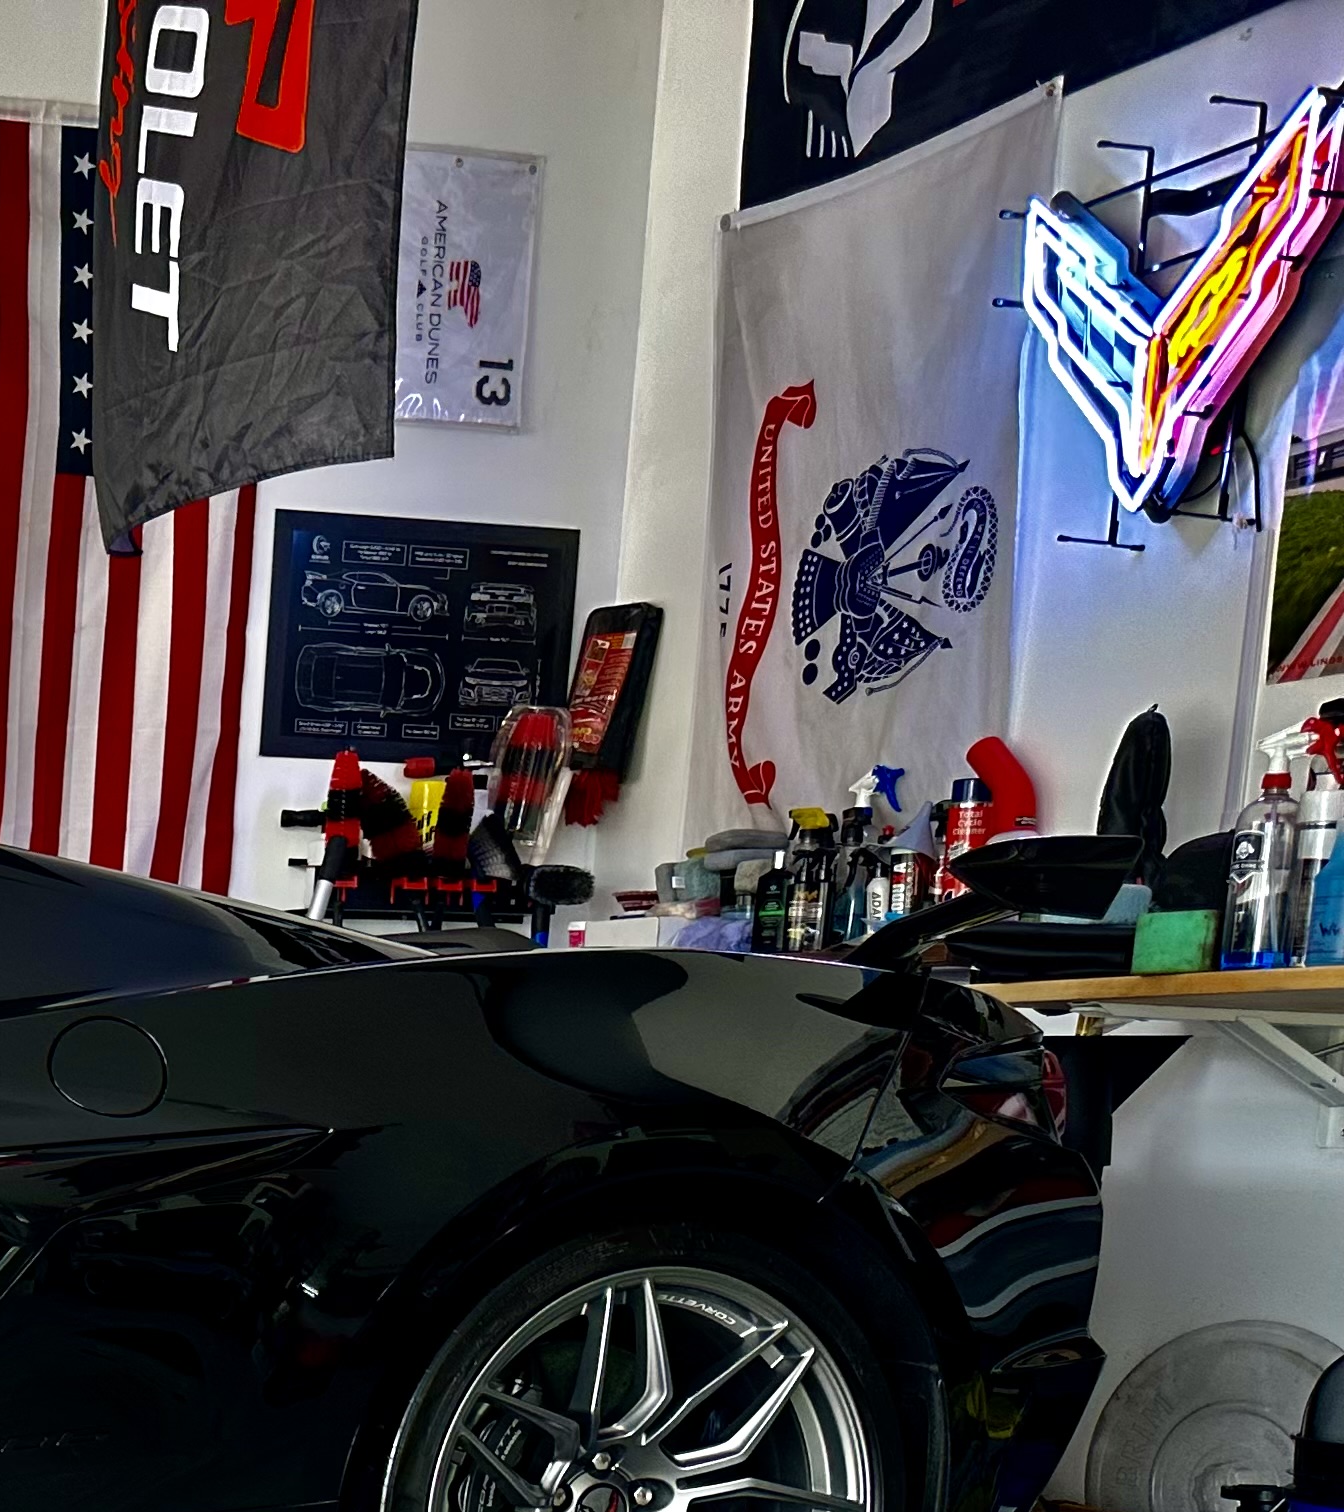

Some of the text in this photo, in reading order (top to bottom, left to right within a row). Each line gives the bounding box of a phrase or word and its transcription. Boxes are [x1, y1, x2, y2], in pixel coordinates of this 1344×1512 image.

[415, 235, 429, 342] GOLF CLUB
[424, 199, 449, 384] AMERICAN DUNES
[475, 358, 514, 407] 13
[726, 423, 777, 768] UNITED STATES ARMY
[656, 1294, 737, 1325] CORVETTE
